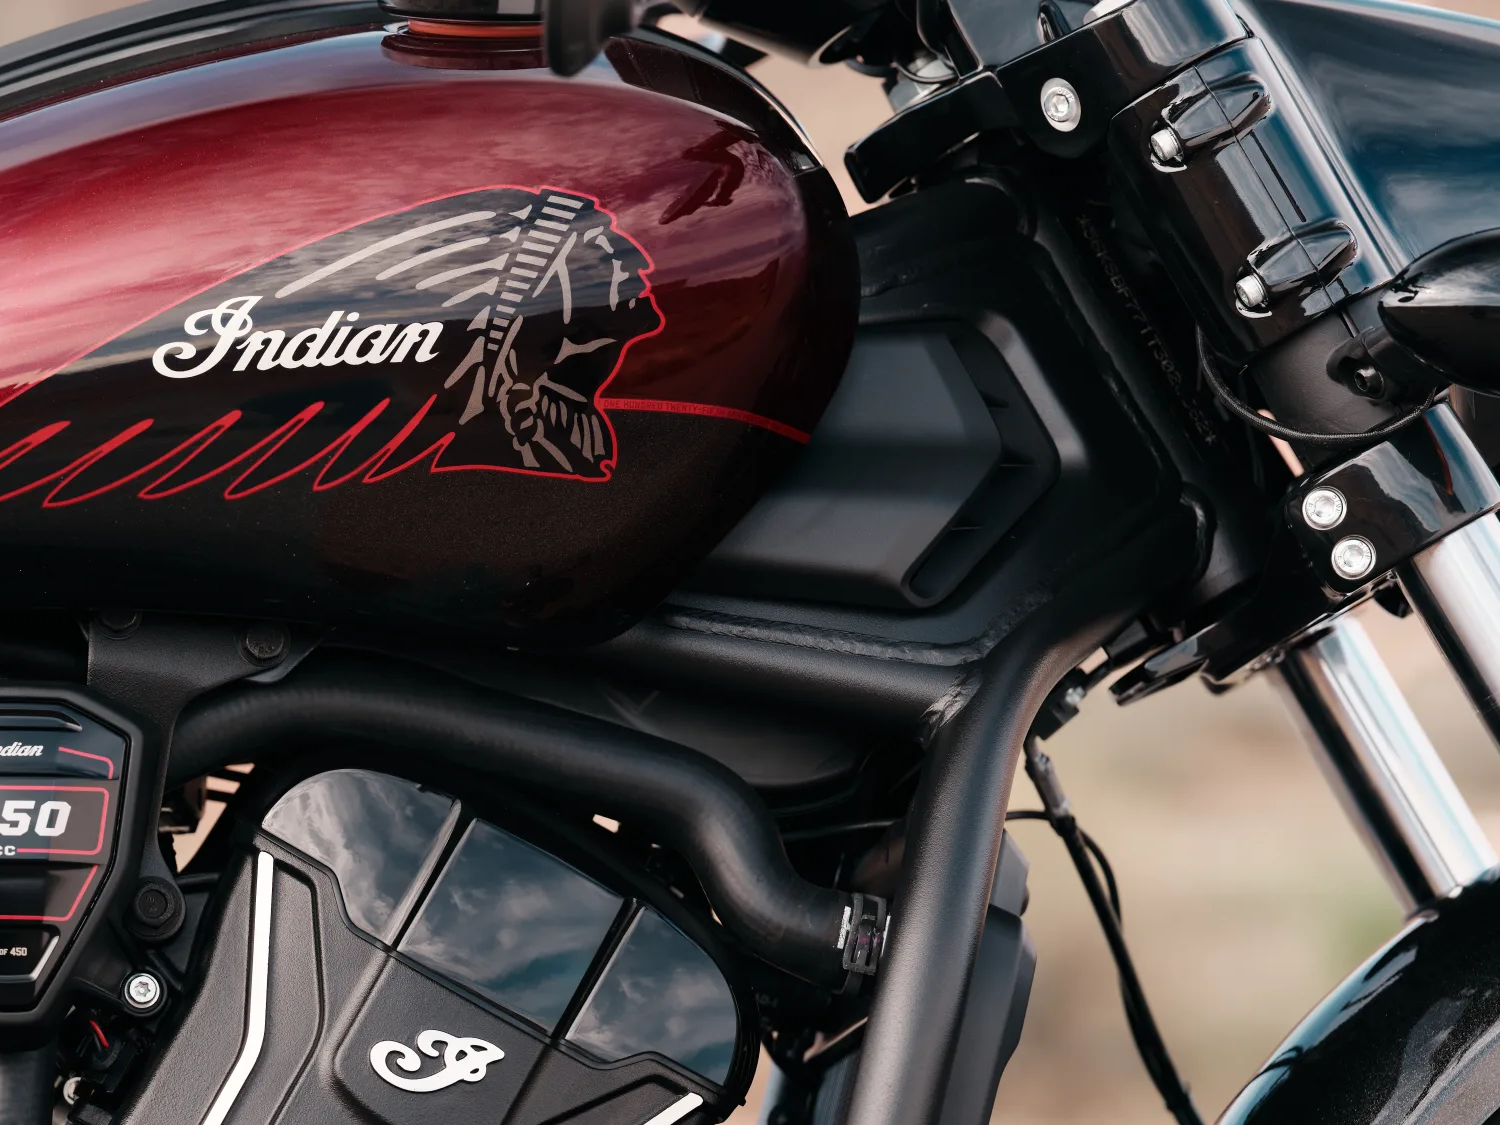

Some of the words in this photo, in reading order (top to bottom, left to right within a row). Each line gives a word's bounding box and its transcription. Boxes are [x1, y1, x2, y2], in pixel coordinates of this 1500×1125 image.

[153, 295, 443, 378] Indian
[603, 401, 620, 409] ONE
[10, 947, 28, 957] 450
